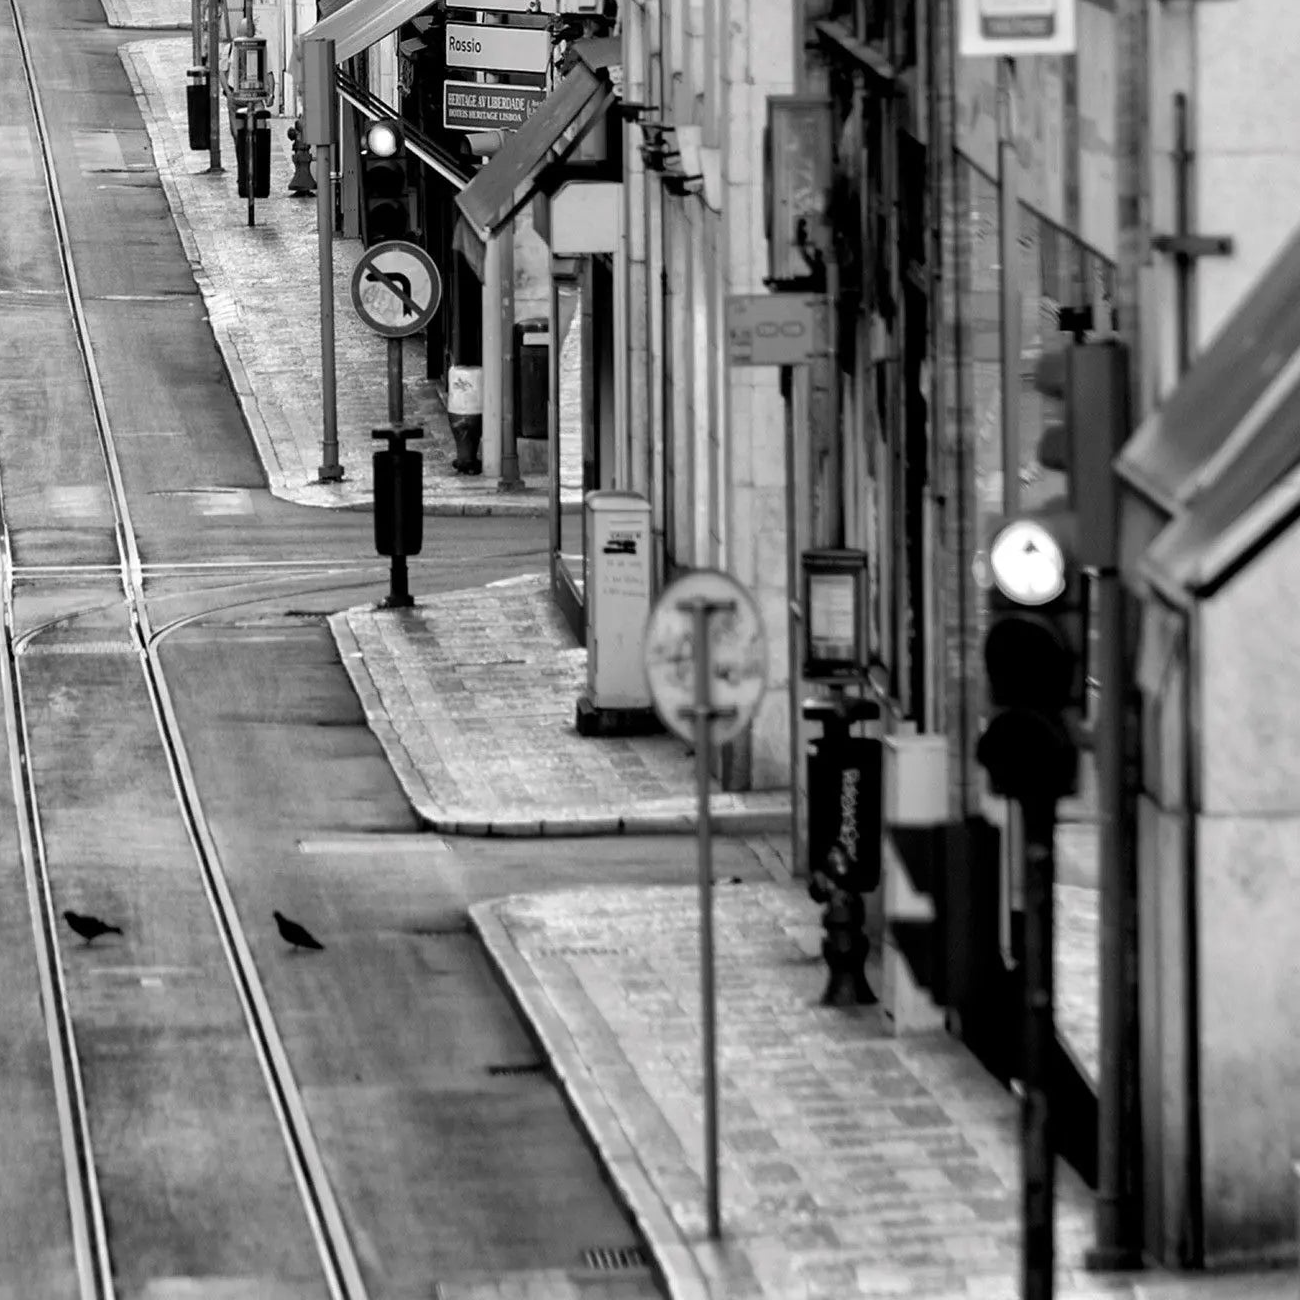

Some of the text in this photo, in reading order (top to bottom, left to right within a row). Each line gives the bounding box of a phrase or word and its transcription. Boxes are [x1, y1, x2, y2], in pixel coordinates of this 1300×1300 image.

[448, 36, 482, 53] Rossio
[448, 93, 477, 107] HERITAGE
[487, 96, 525, 111] LIBERDADE
[498, 112, 523, 122] LISBOA
